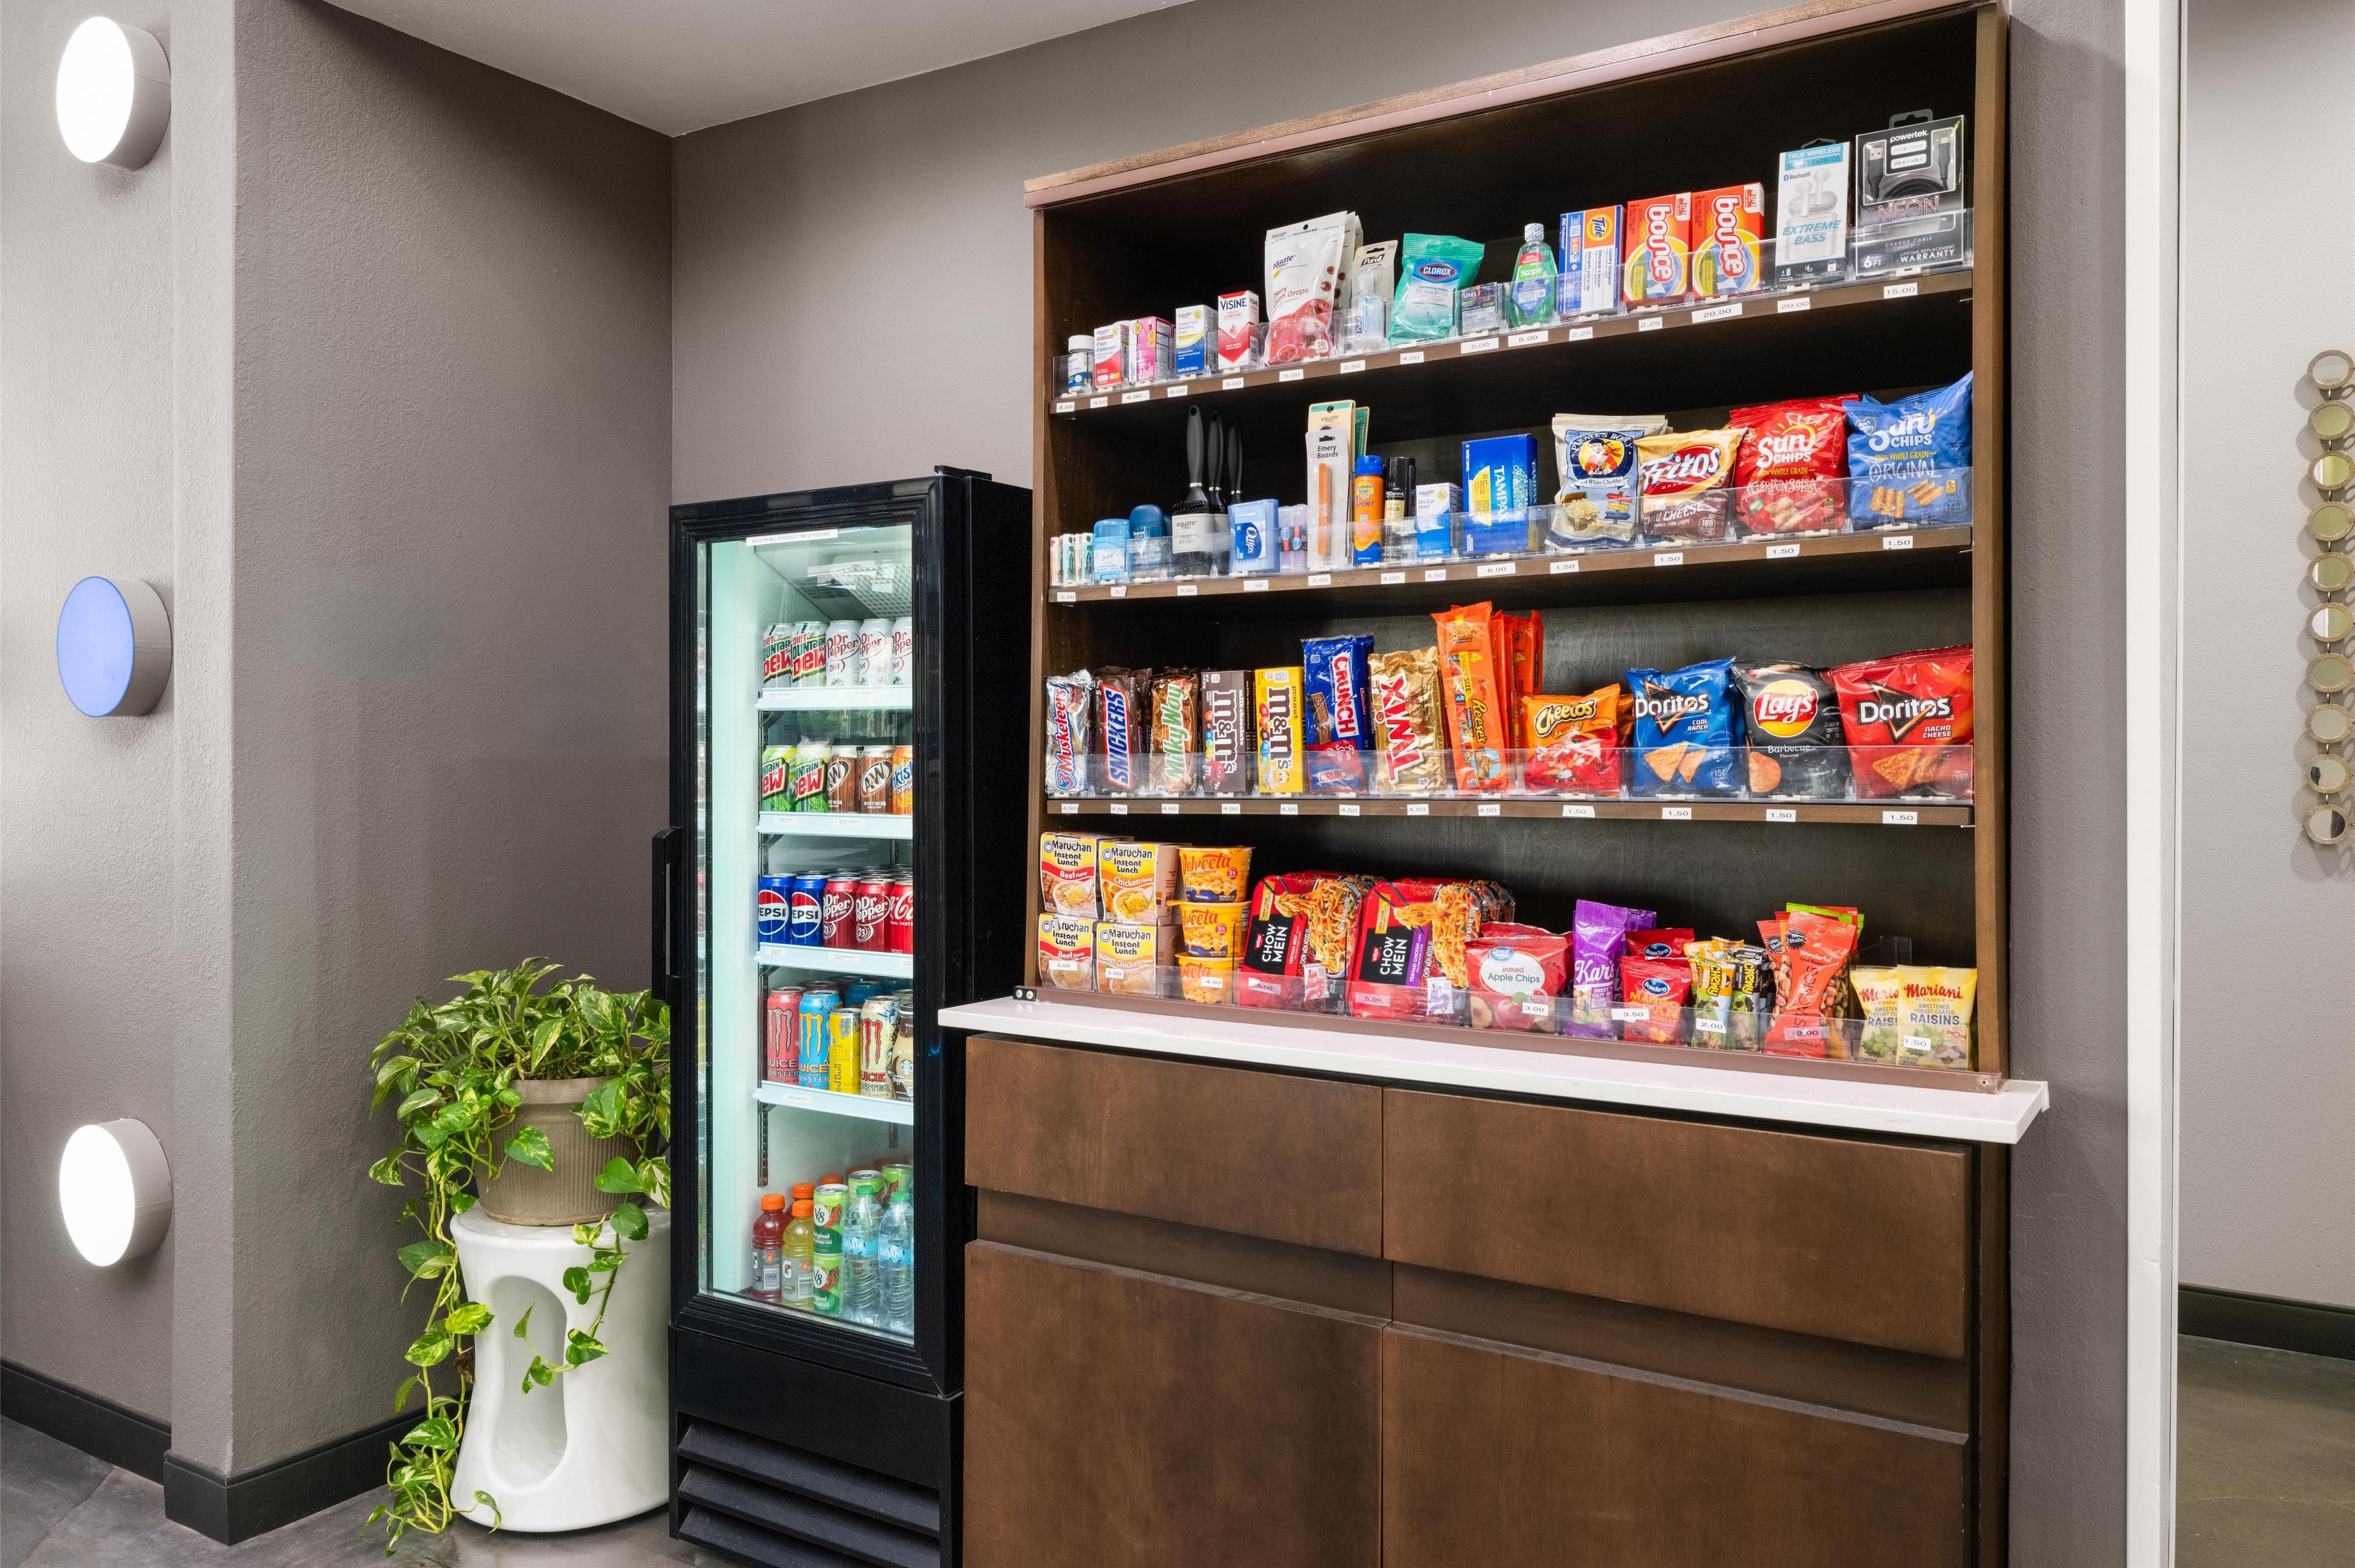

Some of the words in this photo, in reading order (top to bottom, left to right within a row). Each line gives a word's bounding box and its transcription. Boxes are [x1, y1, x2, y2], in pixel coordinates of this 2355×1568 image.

[1807, 147, 1840, 156] WIRELESS
[1878, 196, 1940, 222] NEON
[1591, 216, 1606, 238] Tide
[1782, 220, 1842, 235] EXTREME
[1713, 196, 1746, 277] bounce
[1794, 233, 1827, 245] BASS
[1645, 205, 1674, 283] bounce
[1901, 249, 1955, 262] WARRANTY
[1423, 267, 1452, 277] CLOROX
[1220, 298, 1247, 310] VISINE
[1780, 300, 1809, 309] 20.00
[1703, 308, 1732, 318] 20.00
[1890, 434, 1932, 446] CHIPS
[1773, 453, 1812, 463] CHIPS
[1494, 465, 1509, 522] TAMPAX
[833, 632, 849, 645] Dr
[829, 664, 840, 673] Diet
[1333, 656, 1357, 734] CRUNCH
[1634, 694, 1709, 718] Doritos
[1859, 698, 1951, 724] Doritos
[1536, 700, 1596, 736] Cheetos
[1054, 687, 1074, 773] Musketeers
[1380, 675, 1424, 784] TWIX
[1105, 690, 1130, 787] SNICKERS
[1768, 744, 1810, 754] Barbecue
[864, 763, 884, 792] A&W
[1052, 840, 1092, 853] Maruchan
[1054, 851, 1082, 860] Instant
[1111, 847, 1153, 860] Maruchan
[1057, 858, 1079, 866] Lunch
[1114, 877, 1140, 887] Chicken
[829, 893, 839, 906] Dr
[861, 896, 877, 909] Dr
[792, 910, 819, 919] EPSI
[858, 928, 865, 936] 23
[1052, 931, 1079, 940] Instant
[1109, 928, 1151, 941] Maruchan
[1055, 938, 1076, 947] Lunch
[1262, 924, 1277, 962] CHOW
[1271, 926, 1288, 962] MEIN
[1380, 936, 1395, 975] CHOW
[1391, 939, 1408, 975] MEIN
[1801, 950, 1831, 962] Wonderful
[1488, 973, 1514, 982] Apple
[1515, 974, 1540, 983] Chips
[1904, 984, 1962, 1000] Mariani
[1910, 1013, 1960, 1025] RAISINS
[814, 1206, 824, 1223] V8
[879, 1249, 903, 1258] DASANI
